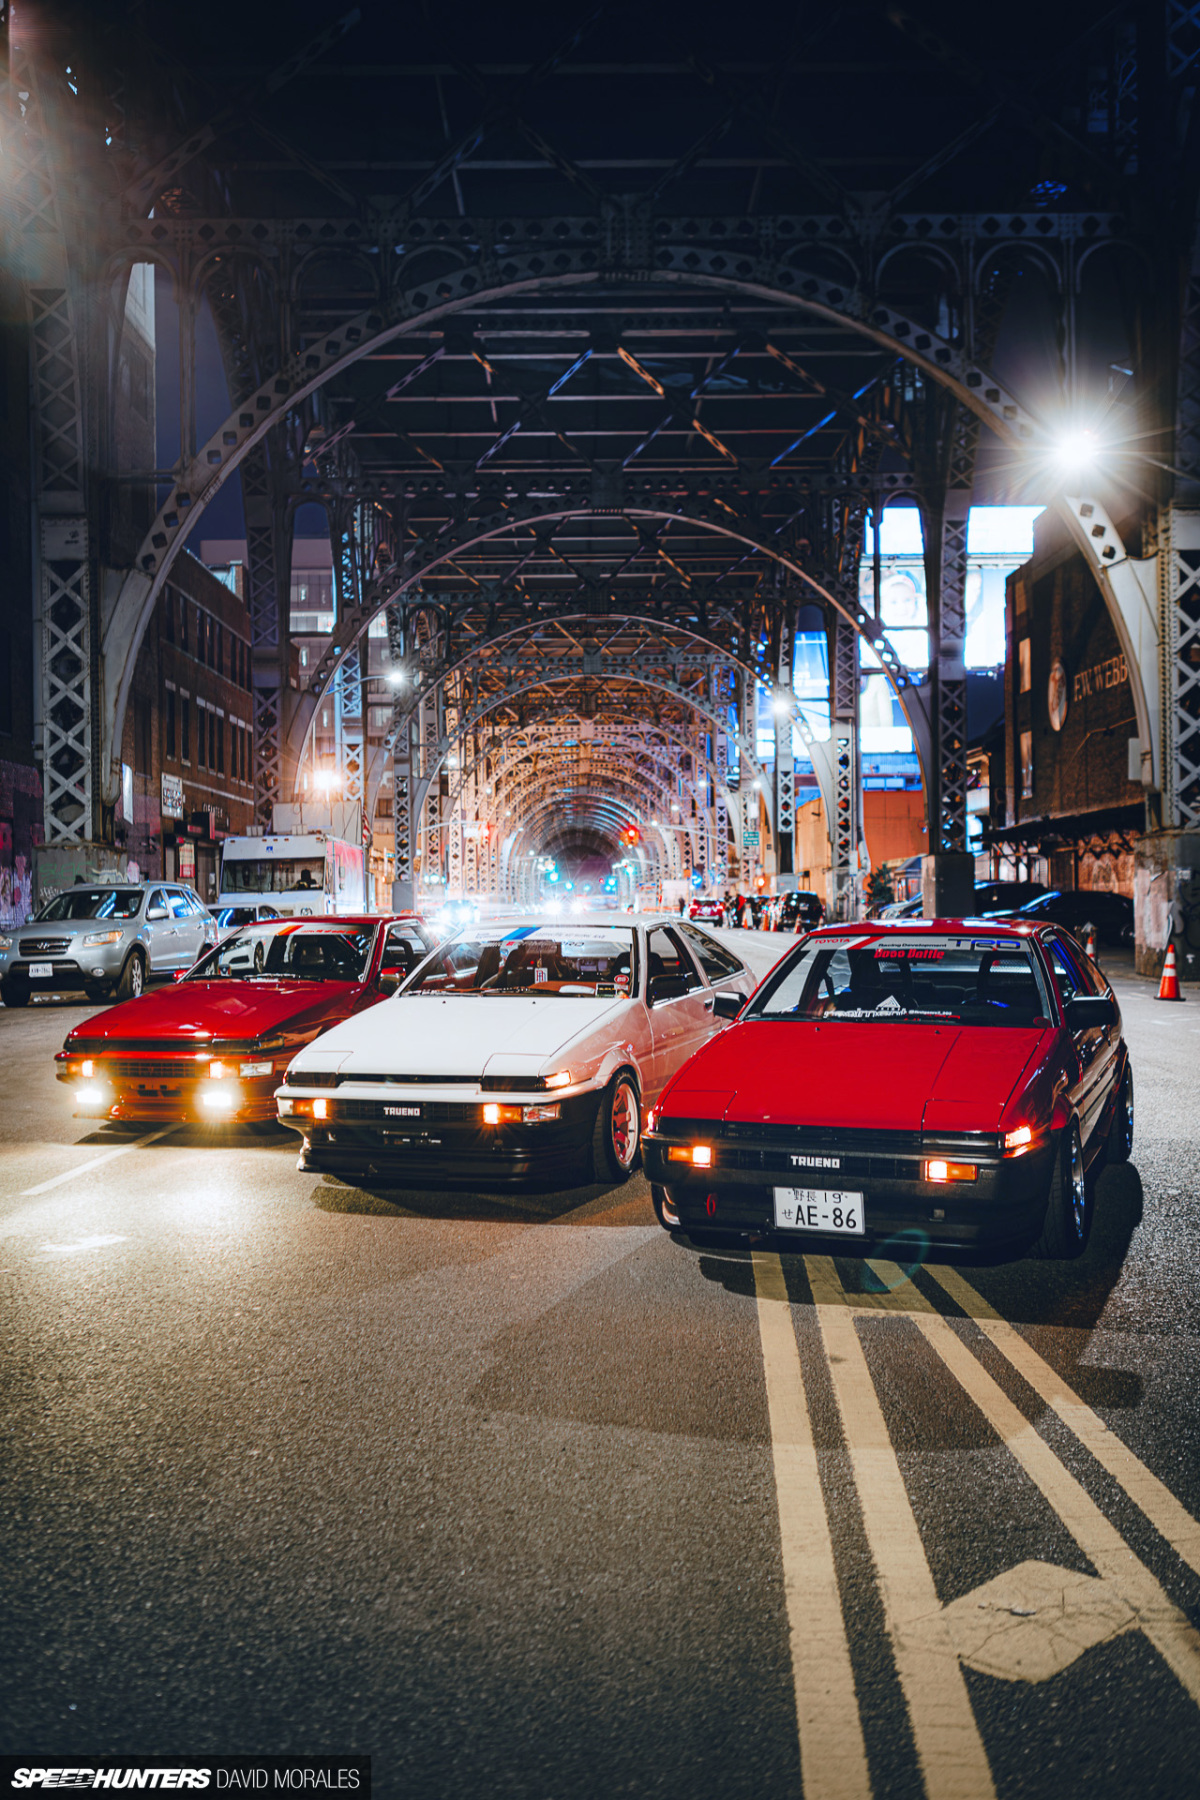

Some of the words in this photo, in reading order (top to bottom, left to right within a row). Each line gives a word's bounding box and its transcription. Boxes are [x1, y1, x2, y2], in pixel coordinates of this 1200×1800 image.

[1094, 654, 1128, 691] WEBB
[948, 938, 1021, 951] TRD
[383, 1106, 420, 1116] TRUENO
[790, 1155, 840, 1168] TRUENO
[795, 1205, 857, 1229] AE-86
